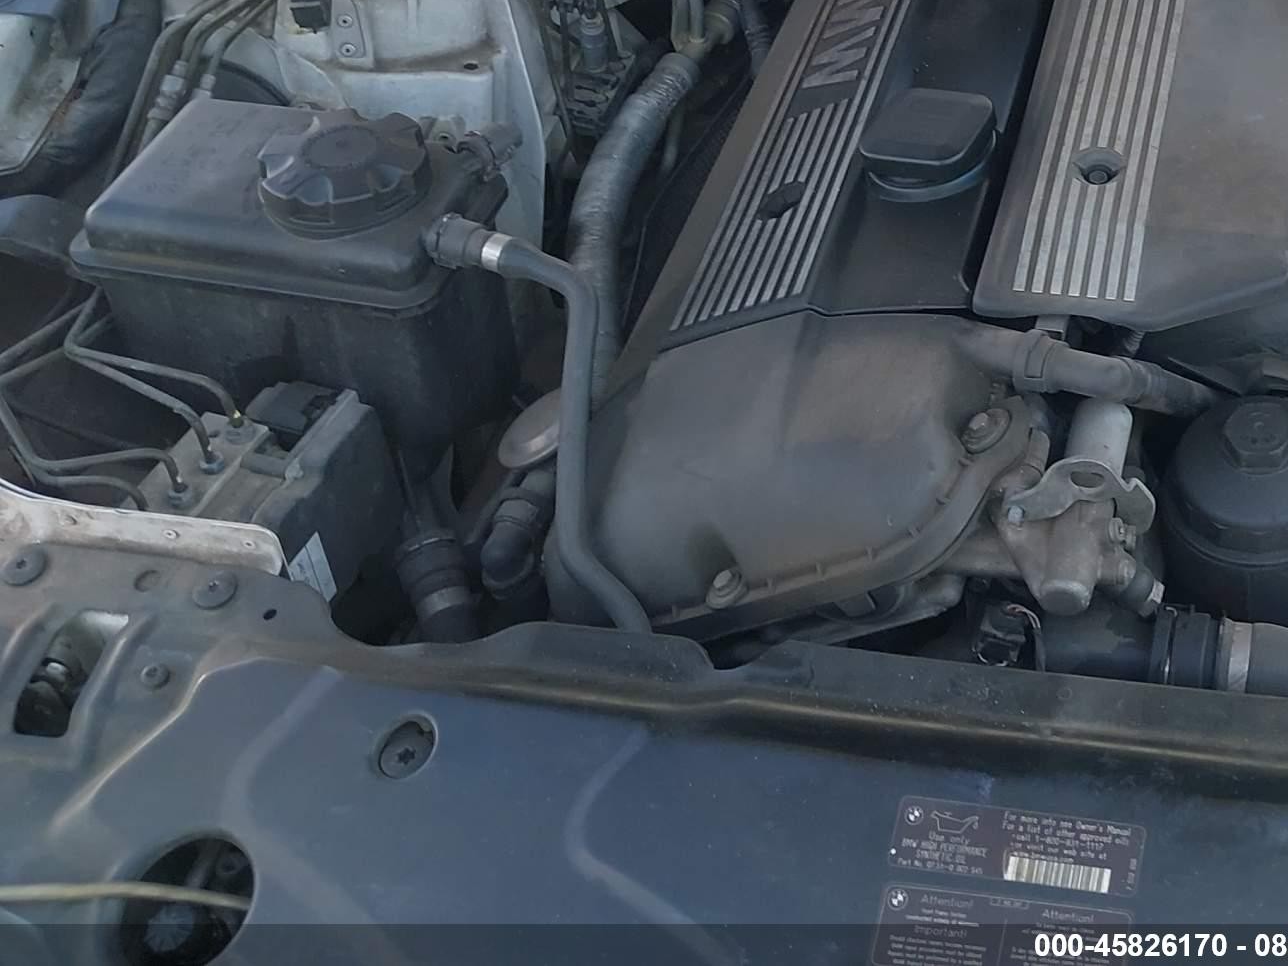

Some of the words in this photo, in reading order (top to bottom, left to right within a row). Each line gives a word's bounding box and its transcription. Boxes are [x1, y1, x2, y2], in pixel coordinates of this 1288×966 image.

[1004, 810, 1017, 821] For
[1020, 815, 1039, 825] more
[1075, 820, 1104, 833] Owner's
[1106, 825, 1132, 836] Manual
[928, 830, 945, 842] Use
[949, 835, 971, 846] only
[921, 894, 974, 909] Attention!
[1041, 908, 1095, 924] Attention!
